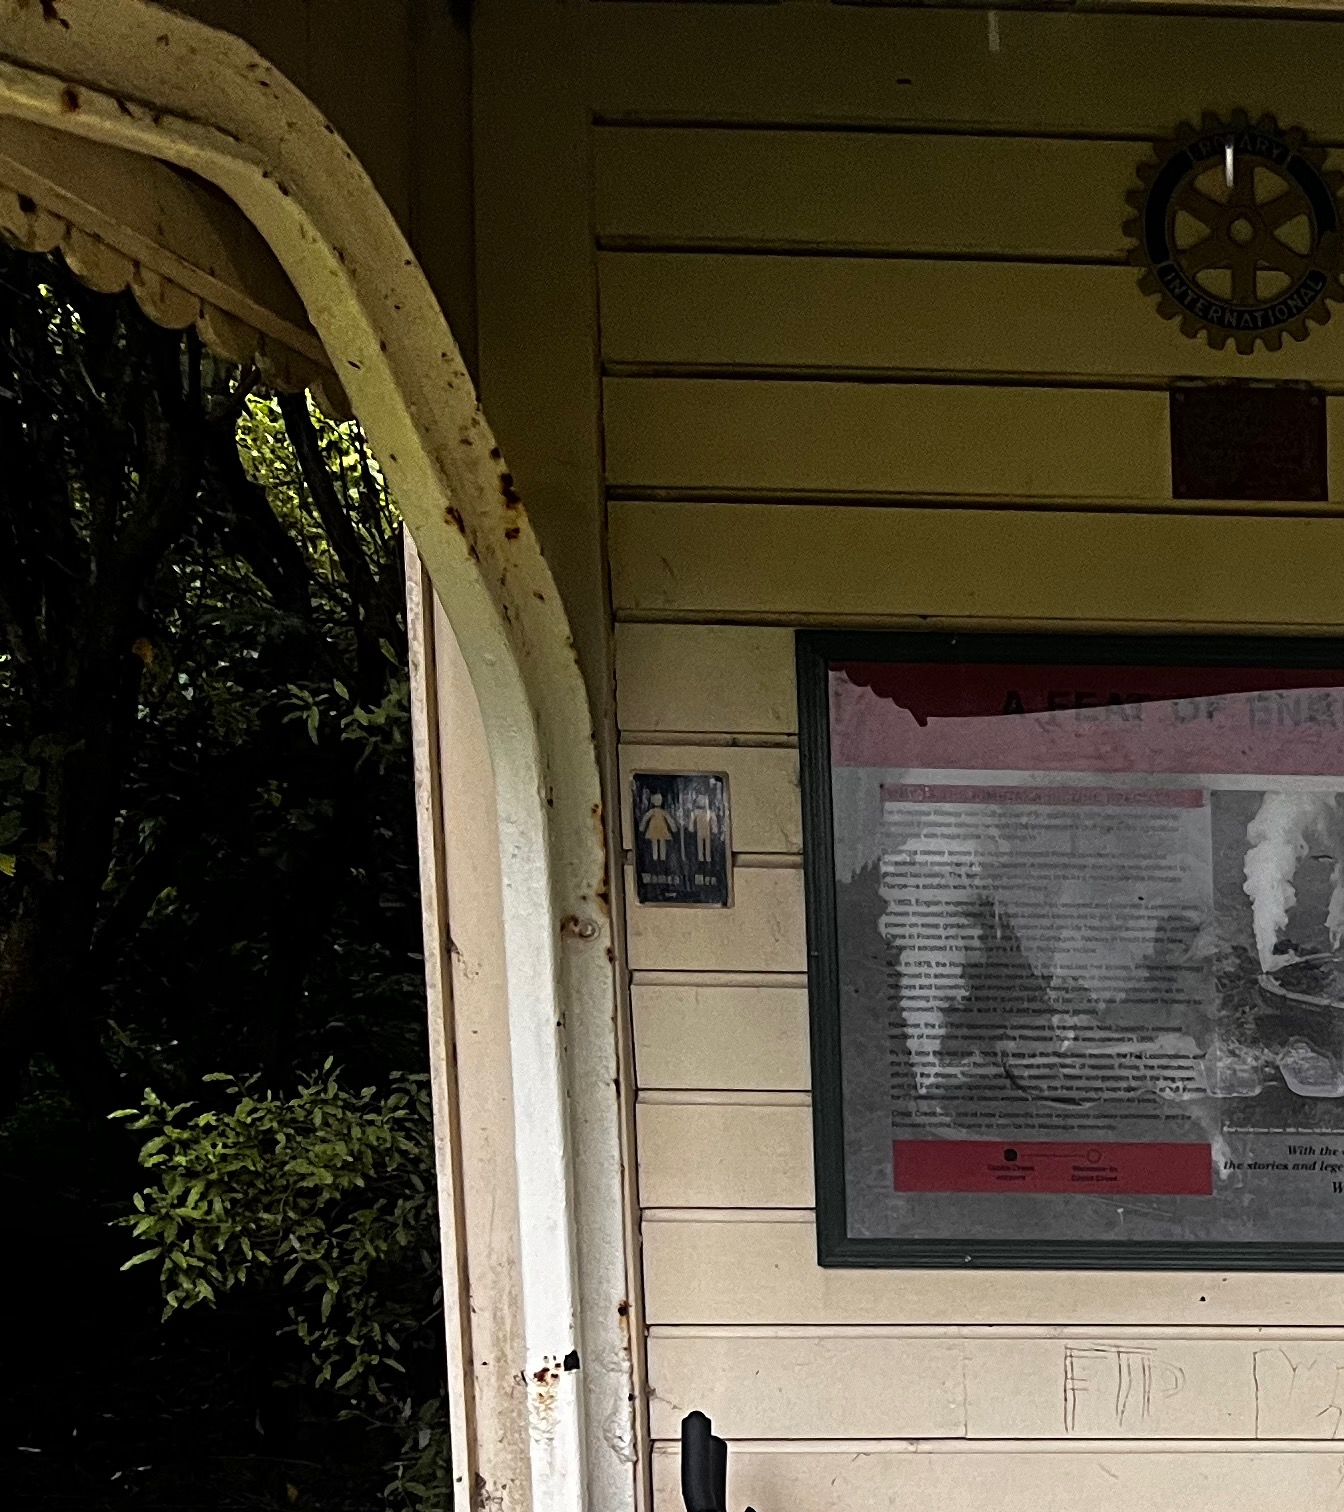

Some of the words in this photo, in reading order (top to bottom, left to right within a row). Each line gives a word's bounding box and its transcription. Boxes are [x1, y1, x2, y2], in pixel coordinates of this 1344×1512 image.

[1167, 271, 1324, 329] INTERNATIONAL
[1288, 1145, 1316, 1157] With
[1319, 1145, 1338, 1157] the
[1223, 1159, 1244, 1170] the
[1247, 1160, 1289, 1171] stories
[1292, 1160, 1316, 1171] and
